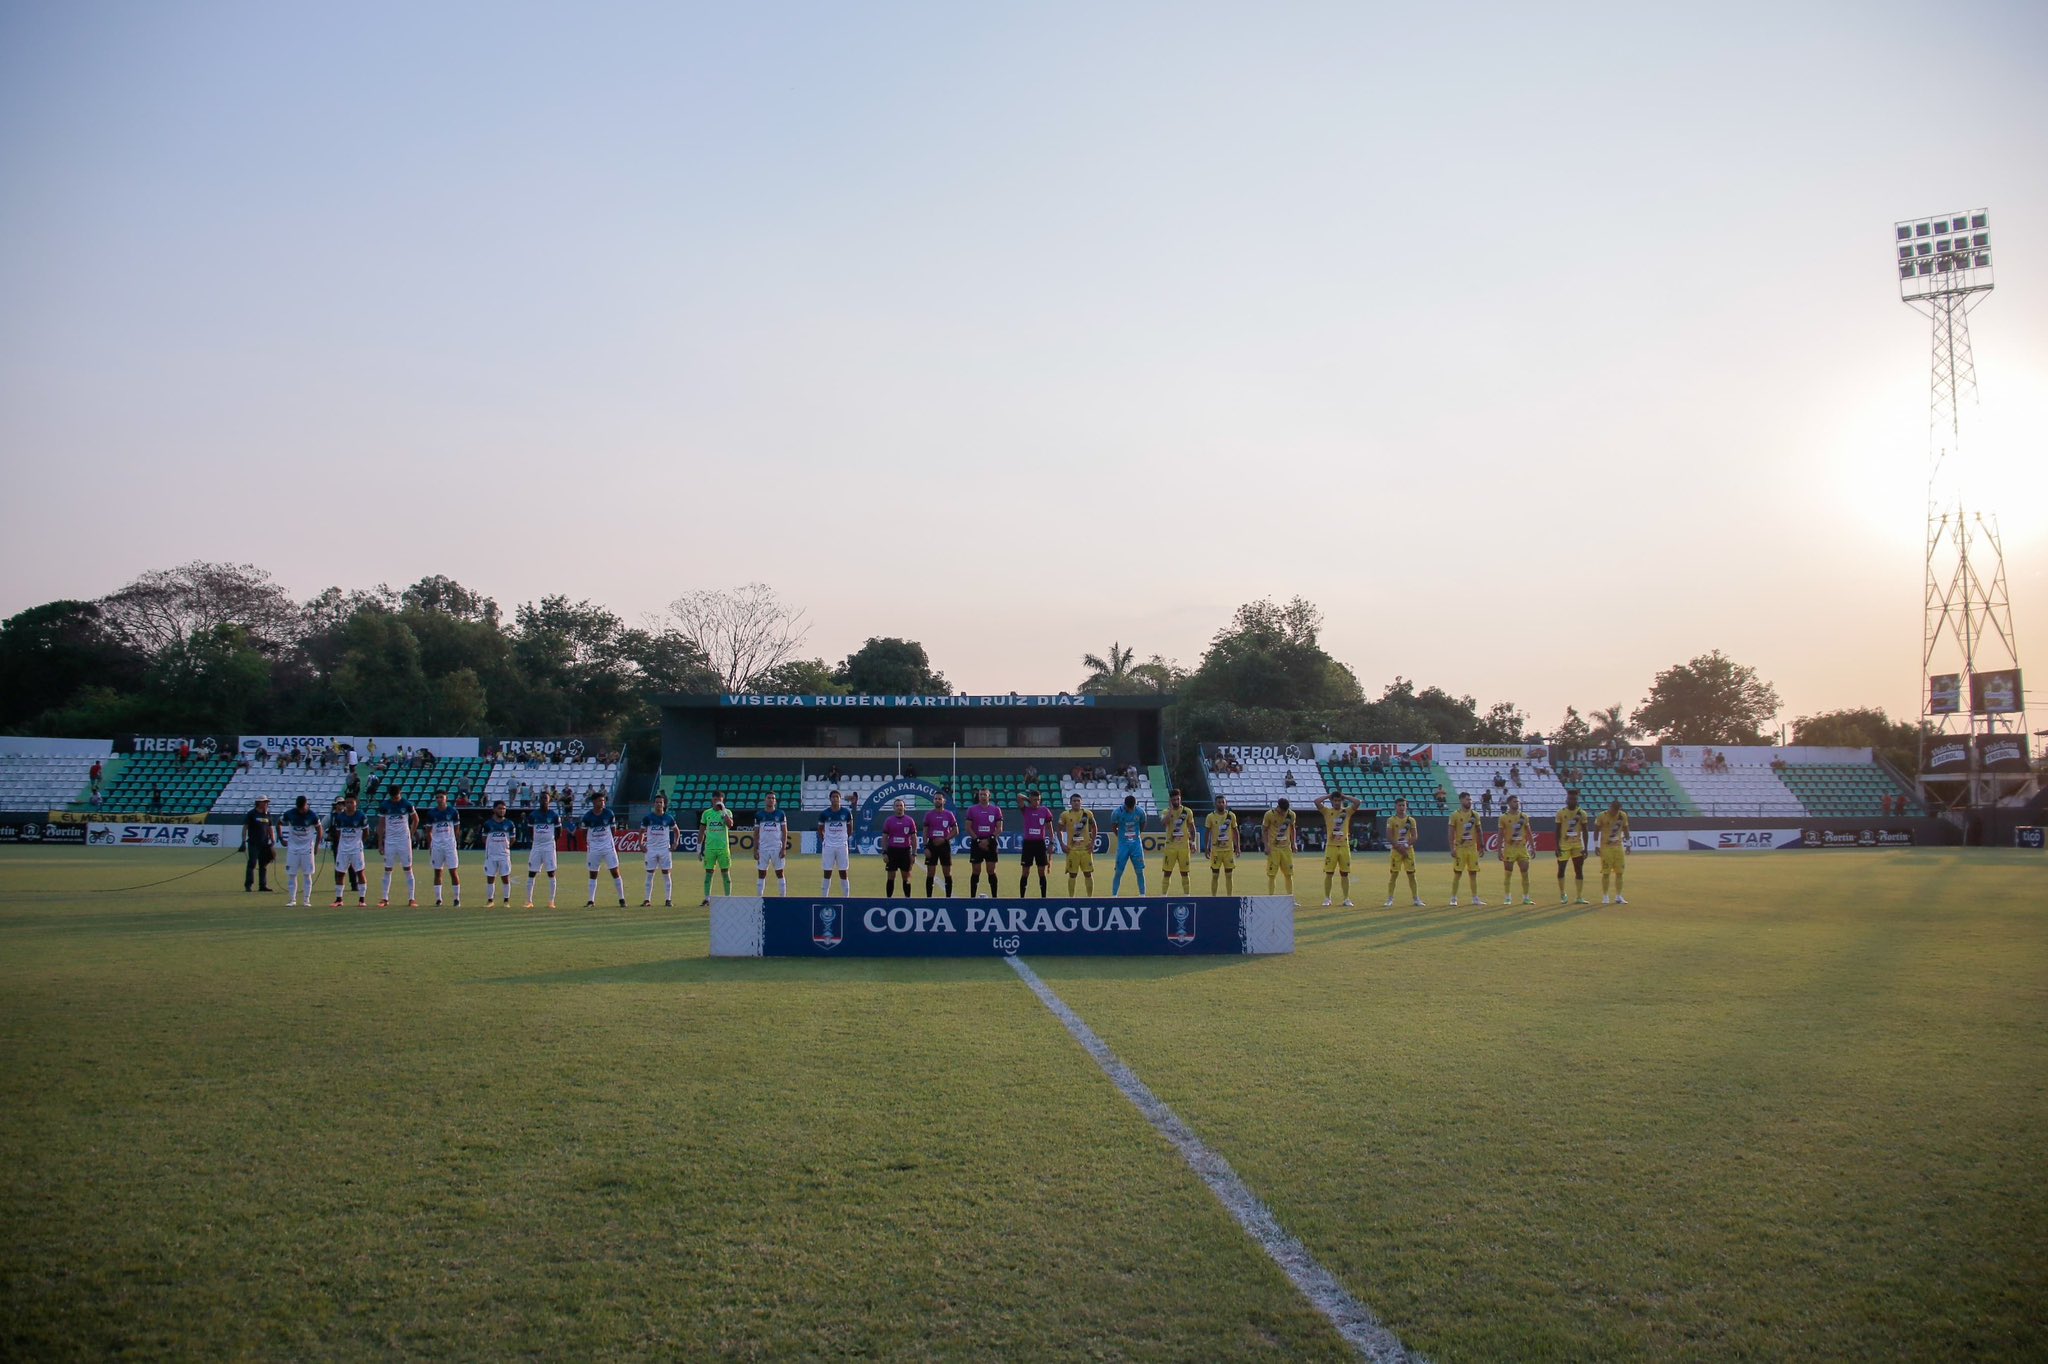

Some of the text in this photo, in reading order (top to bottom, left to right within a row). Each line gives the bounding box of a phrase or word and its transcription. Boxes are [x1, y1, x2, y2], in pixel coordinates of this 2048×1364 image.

[729, 695, 1085, 706] VISERA RUBEN MARTIN RUIZ DIAZ
[267, 737, 324, 747] BLASCOR
[1218, 746, 1284, 759] TREBOL
[1466, 747, 1522, 758] BLASCORMIX
[873, 782, 937, 803] COPA PARAGU
[122, 826, 189, 839] STAR
[1719, 832, 1773, 843] STAR
[863, 906, 1147, 932] COPA PARAGUAY
